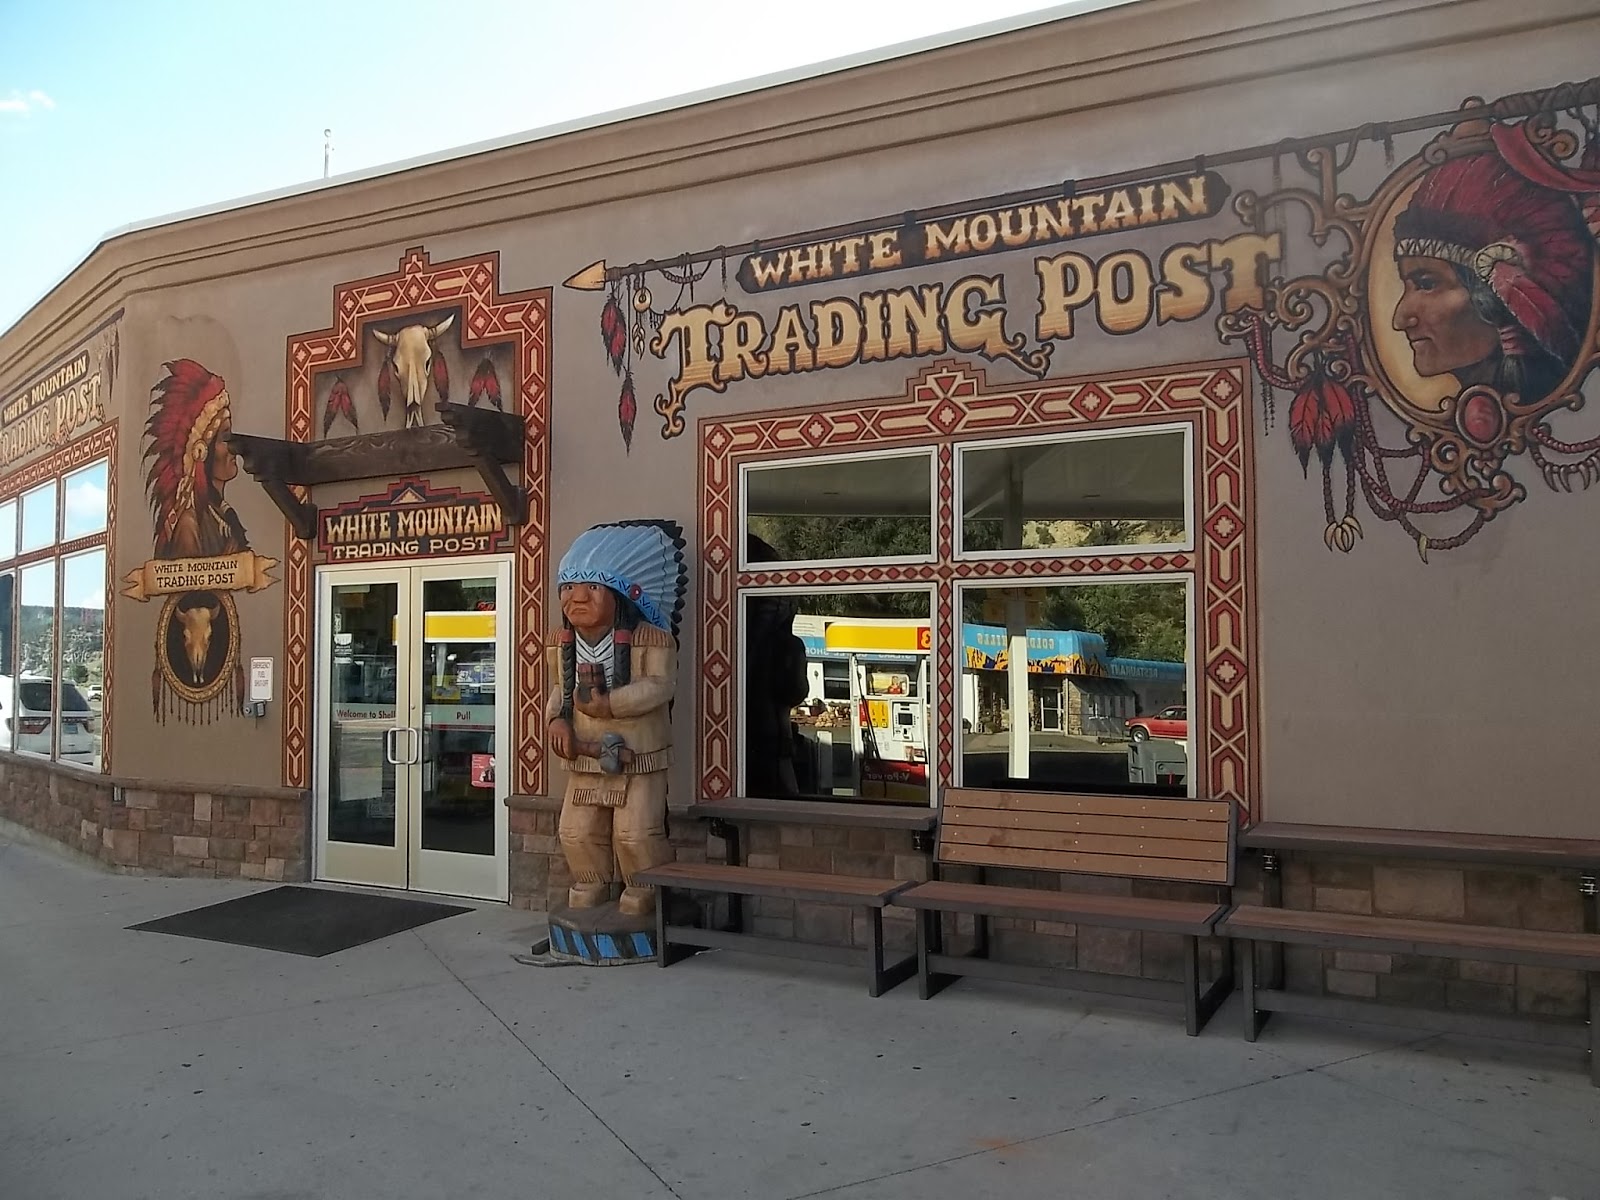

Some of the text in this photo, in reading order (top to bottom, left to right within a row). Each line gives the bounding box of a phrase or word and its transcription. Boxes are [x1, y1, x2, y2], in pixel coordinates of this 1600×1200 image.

[750, 175, 1209, 289] WHITE MOUNTAIN
[650, 232, 1283, 439] TRADING POST
[3, 355, 87, 424] WHITE MOUNTAIN
[0, 371, 107, 468] RADING POST
[325, 503, 502, 544] WHITE MOUNTAIN
[333, 536, 489, 559] TRADING POST
[154, 560, 238, 574] WHITE MOUNTAIN
[157, 573, 235, 588] TRADING POST
[336, 709, 396, 719] Welcome to Shell
[456, 711, 471, 720] Pull
